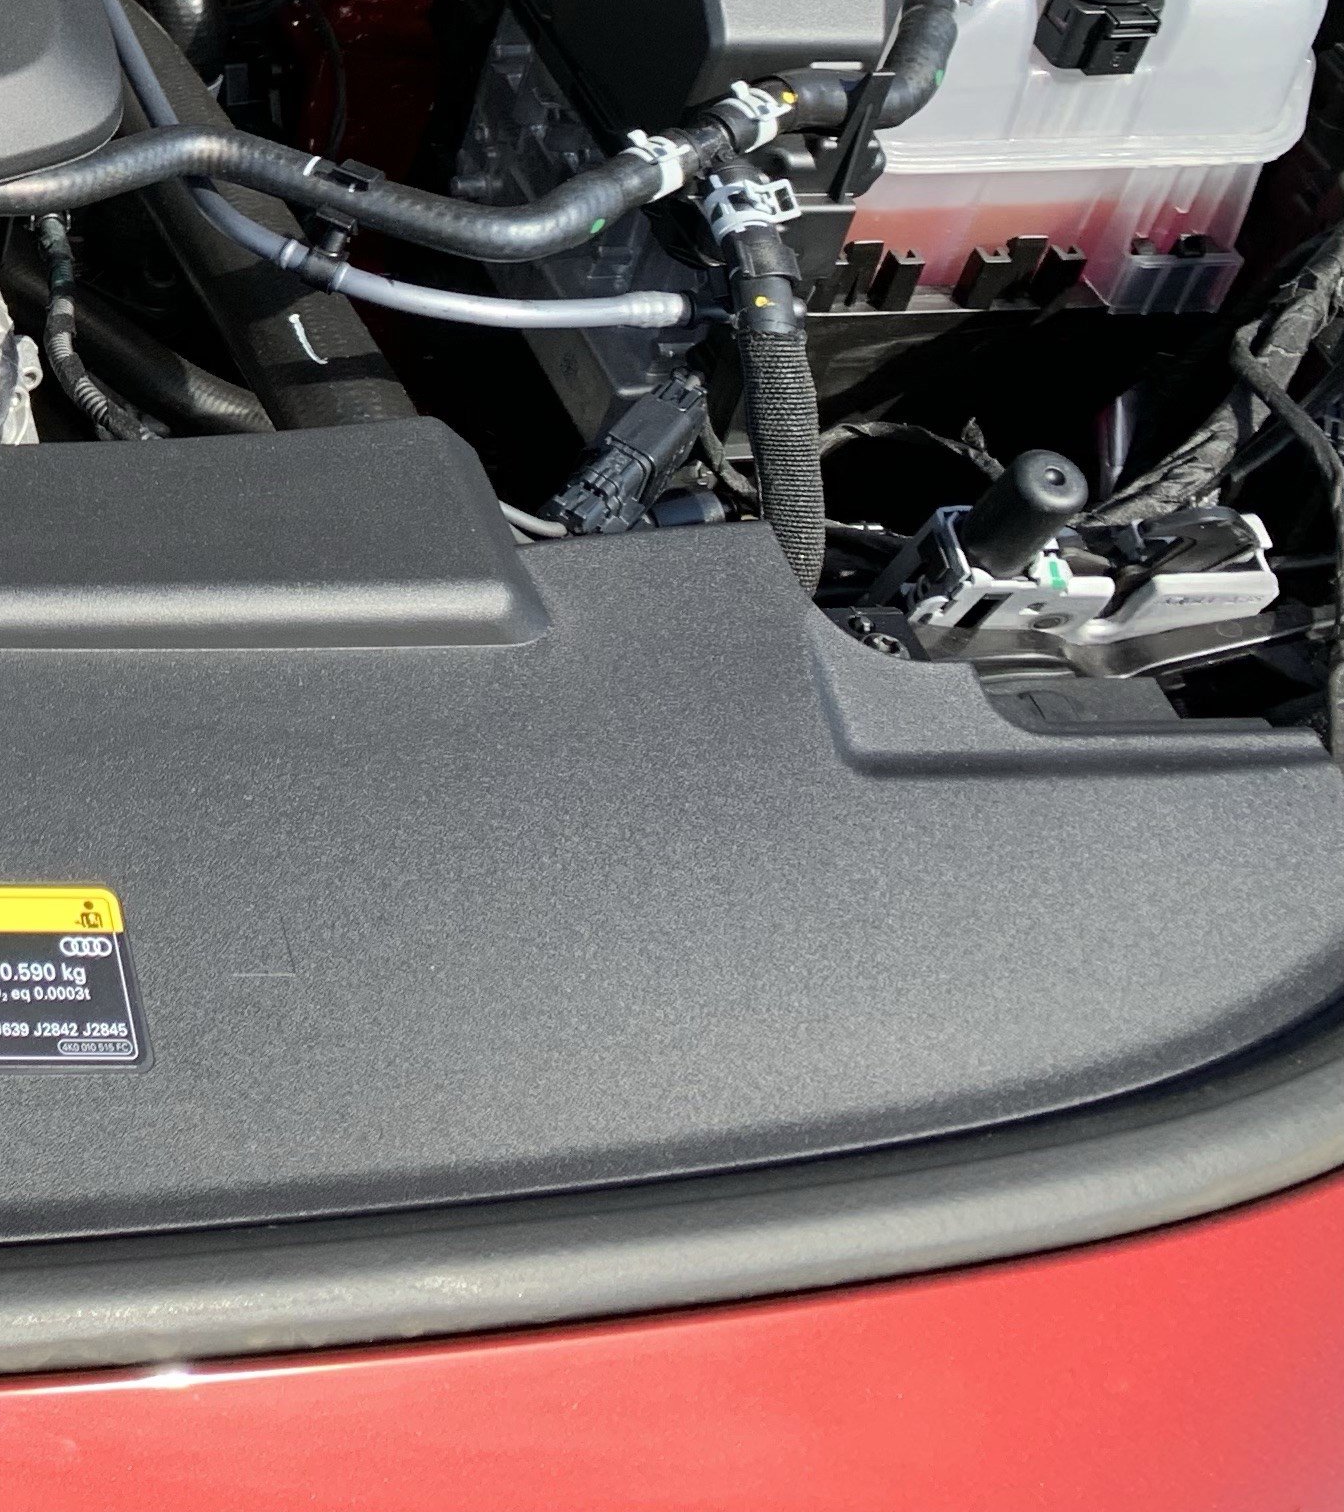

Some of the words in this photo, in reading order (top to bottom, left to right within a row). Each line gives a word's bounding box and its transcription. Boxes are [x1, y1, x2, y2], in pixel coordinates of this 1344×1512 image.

[0, 963, 56, 982] 0.590
[61, 963, 88, 986] kg
[10, 989, 31, 1002] eq
[33, 986, 92, 1001] 0.0003t
[33, 1022, 80, 1038] J2842
[82, 1022, 129, 1038] J2845
